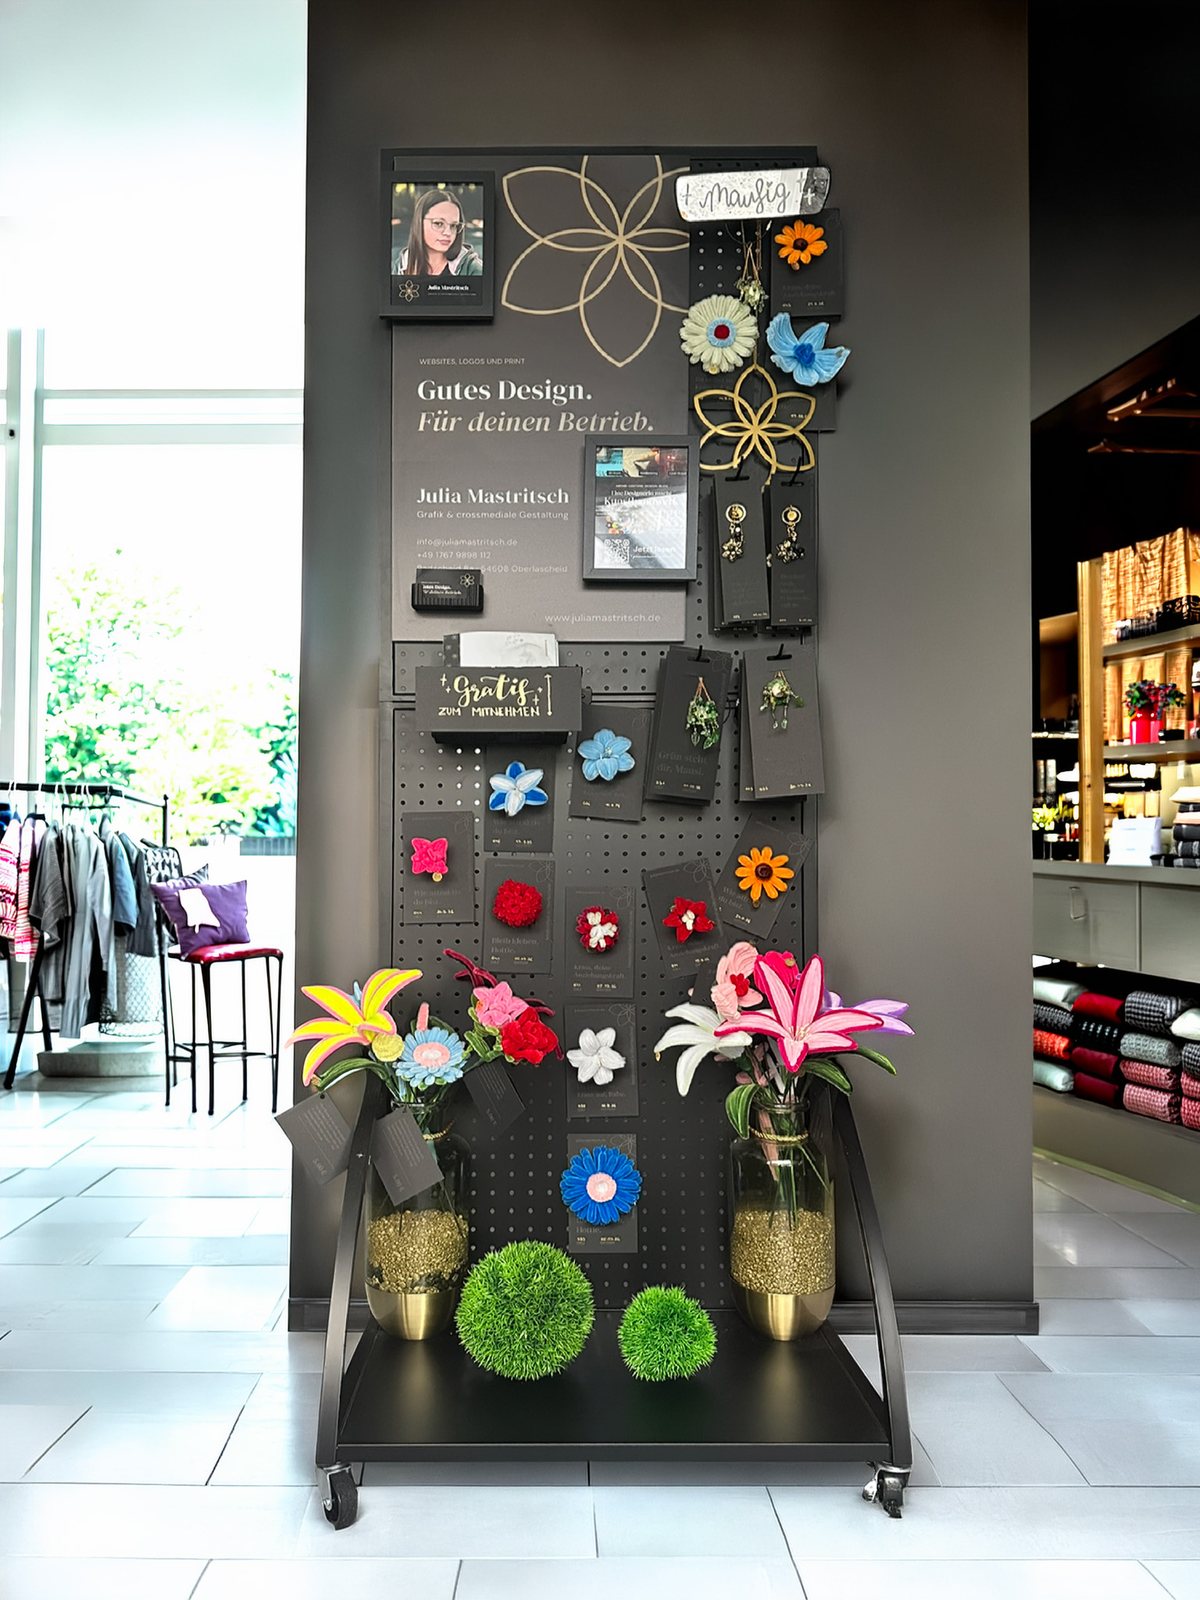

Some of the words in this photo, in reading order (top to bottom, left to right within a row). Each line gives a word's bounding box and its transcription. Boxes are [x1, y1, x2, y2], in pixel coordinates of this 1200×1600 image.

[419, 358, 458, 366] WEBSITES,
[417, 379, 492, 401] Gutes
[498, 378, 593, 407] Design.
[417, 409, 464, 432] Für
[467, 410, 551, 432] deinen
[557, 410, 655, 432] Betrieb.
[416, 487, 462, 504] Julia
[466, 487, 570, 504] Mastritsch
[416, 510, 445, 519] Grafik
[446, 510, 455, 519] &
[456, 510, 518, 519] crossmediale
[519, 510, 569, 520] Gestaltung
[416, 537, 519, 547] info@juliamastritsch.de
[435, 551, 454, 559] 1767
[455, 551, 479, 559] 9898
[479, 551, 492, 559] 112
[510, 564, 569, 574] Oberlascheid
[544, 613, 661, 624] www.juliamastritsch.de
[453, 674, 534, 708] Gratis
[438, 706, 462, 717] ZUM
[471, 705, 541, 717] MITNEHMEN
